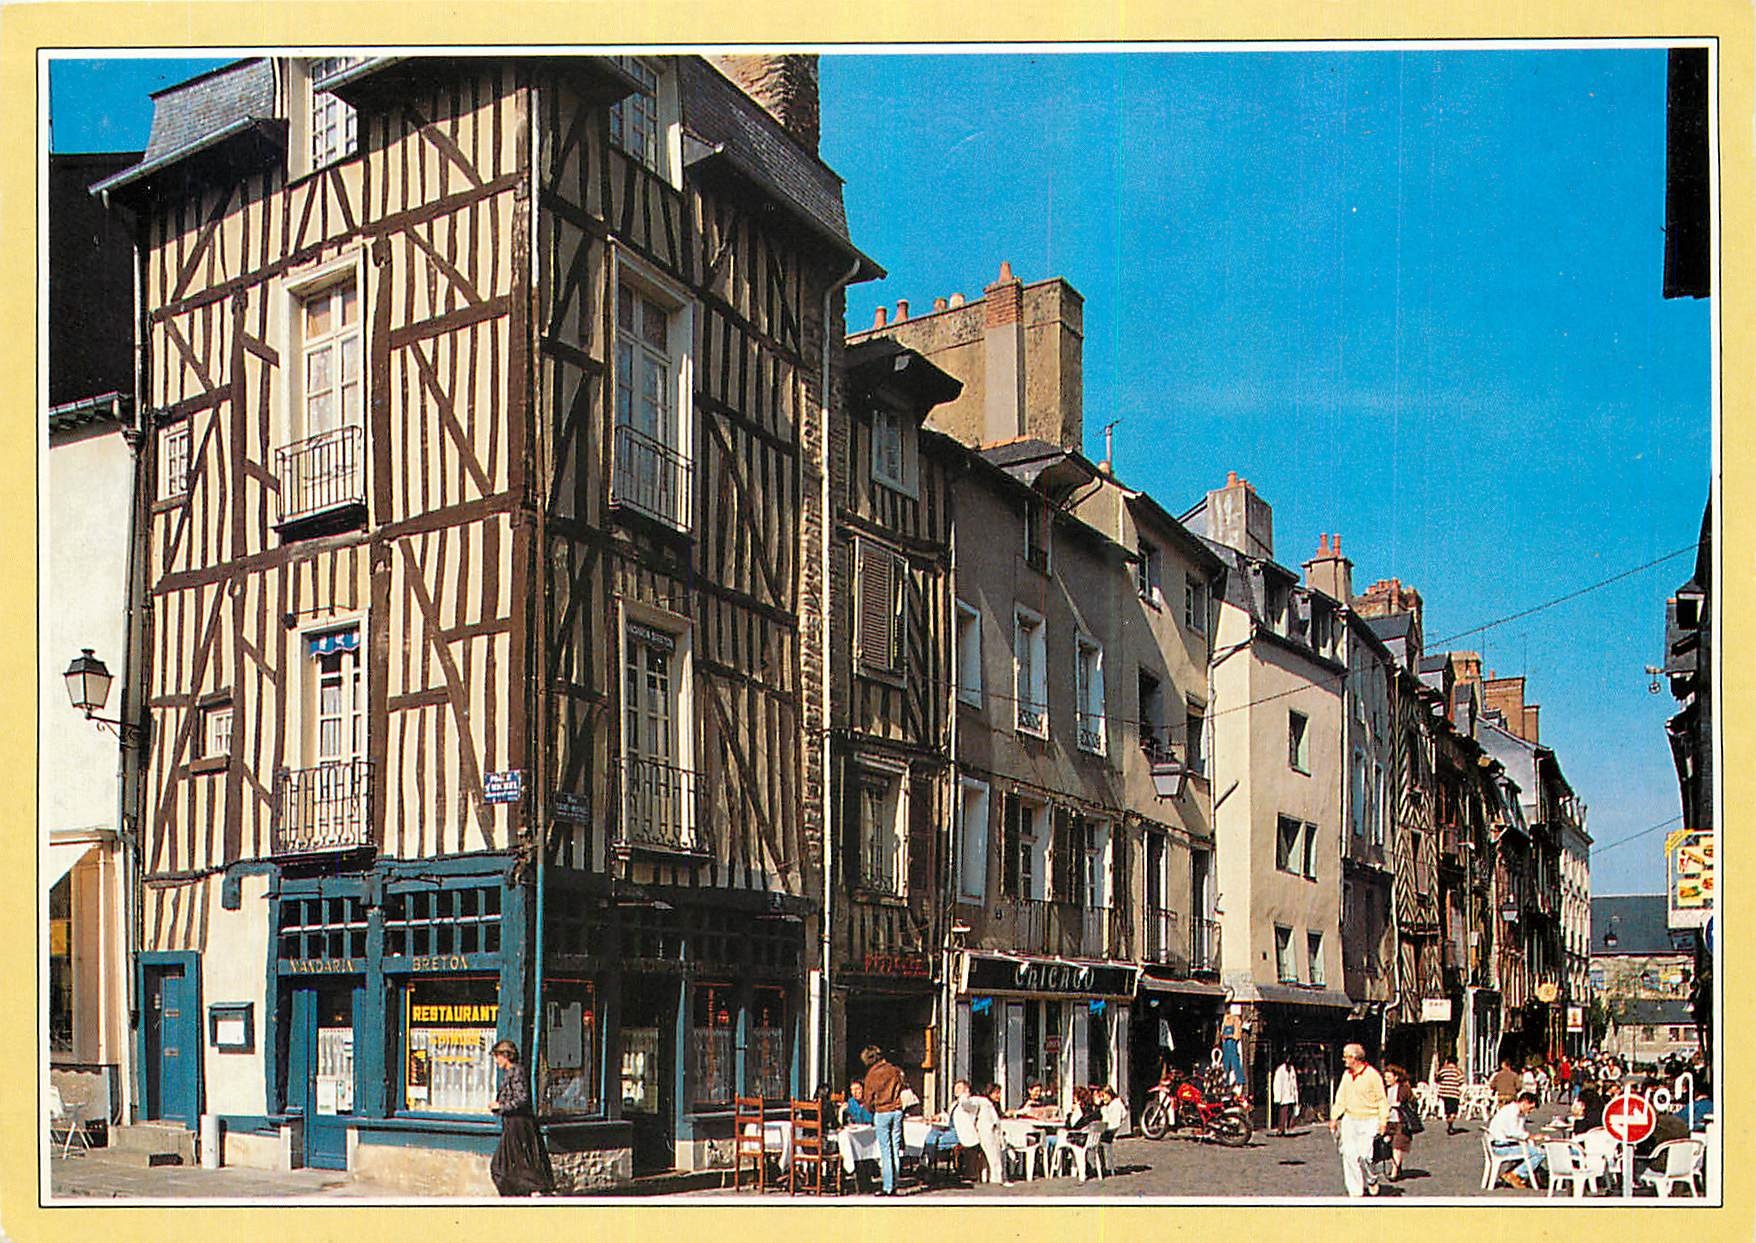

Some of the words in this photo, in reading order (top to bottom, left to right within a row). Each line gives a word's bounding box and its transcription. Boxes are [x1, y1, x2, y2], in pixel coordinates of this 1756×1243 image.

[289, 956, 354, 973] MANDARIN
[412, 955, 468, 972] BRETON
[412, 1005, 499, 1022] RESTAURANT
